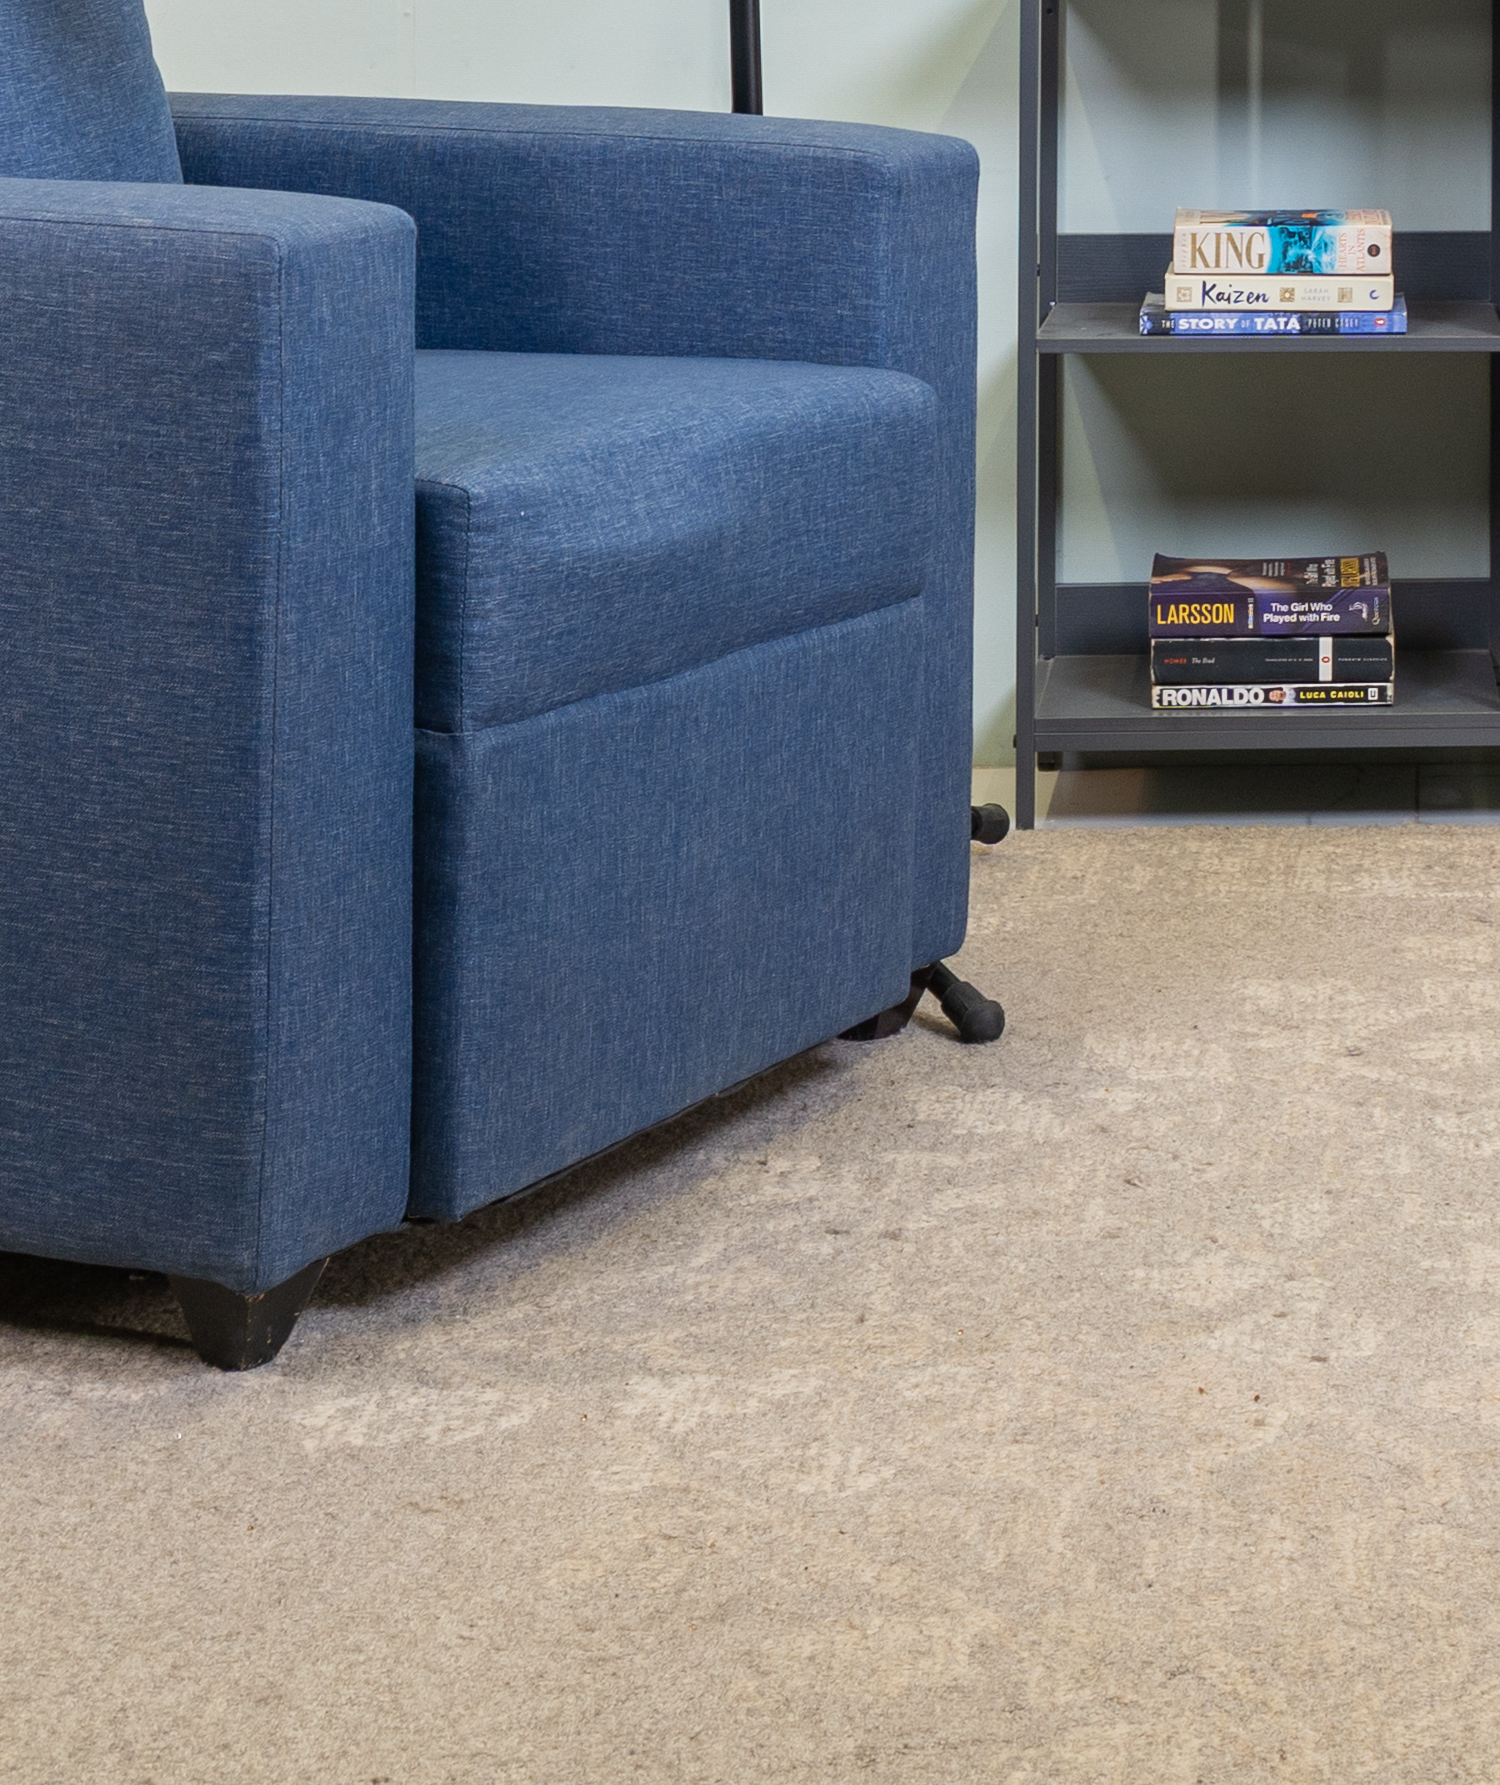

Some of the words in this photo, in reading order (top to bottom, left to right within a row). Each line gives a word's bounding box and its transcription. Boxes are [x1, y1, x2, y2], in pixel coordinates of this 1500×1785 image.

[1190, 231, 1265, 269] KING
[1338, 232, 1347, 268] HEARTS
[1348, 245, 1356, 255] IN
[1356, 228, 1365, 272] ATLANTIS
[1202, 280, 1270, 308] Kaizen
[1162, 320, 1175, 329] THE
[1179, 318, 1239, 330] STORY
[1241, 319, 1250, 328] OF
[1254, 317, 1301, 331] TATA
[1157, 603, 1234, 625] LARSSON
[1270, 603, 1289, 612] The
[1291, 602, 1308, 612] Girl
[1310, 602, 1333, 612] Who
[1263, 613, 1297, 624] Played
[1298, 613, 1319, 622] with
[1321, 613, 1340, 622] Fire
[1162, 687, 1265, 706] RONALDO
[1300, 691, 1326, 699] LUCA
[1330, 690, 1364, 699] CAIOLI
